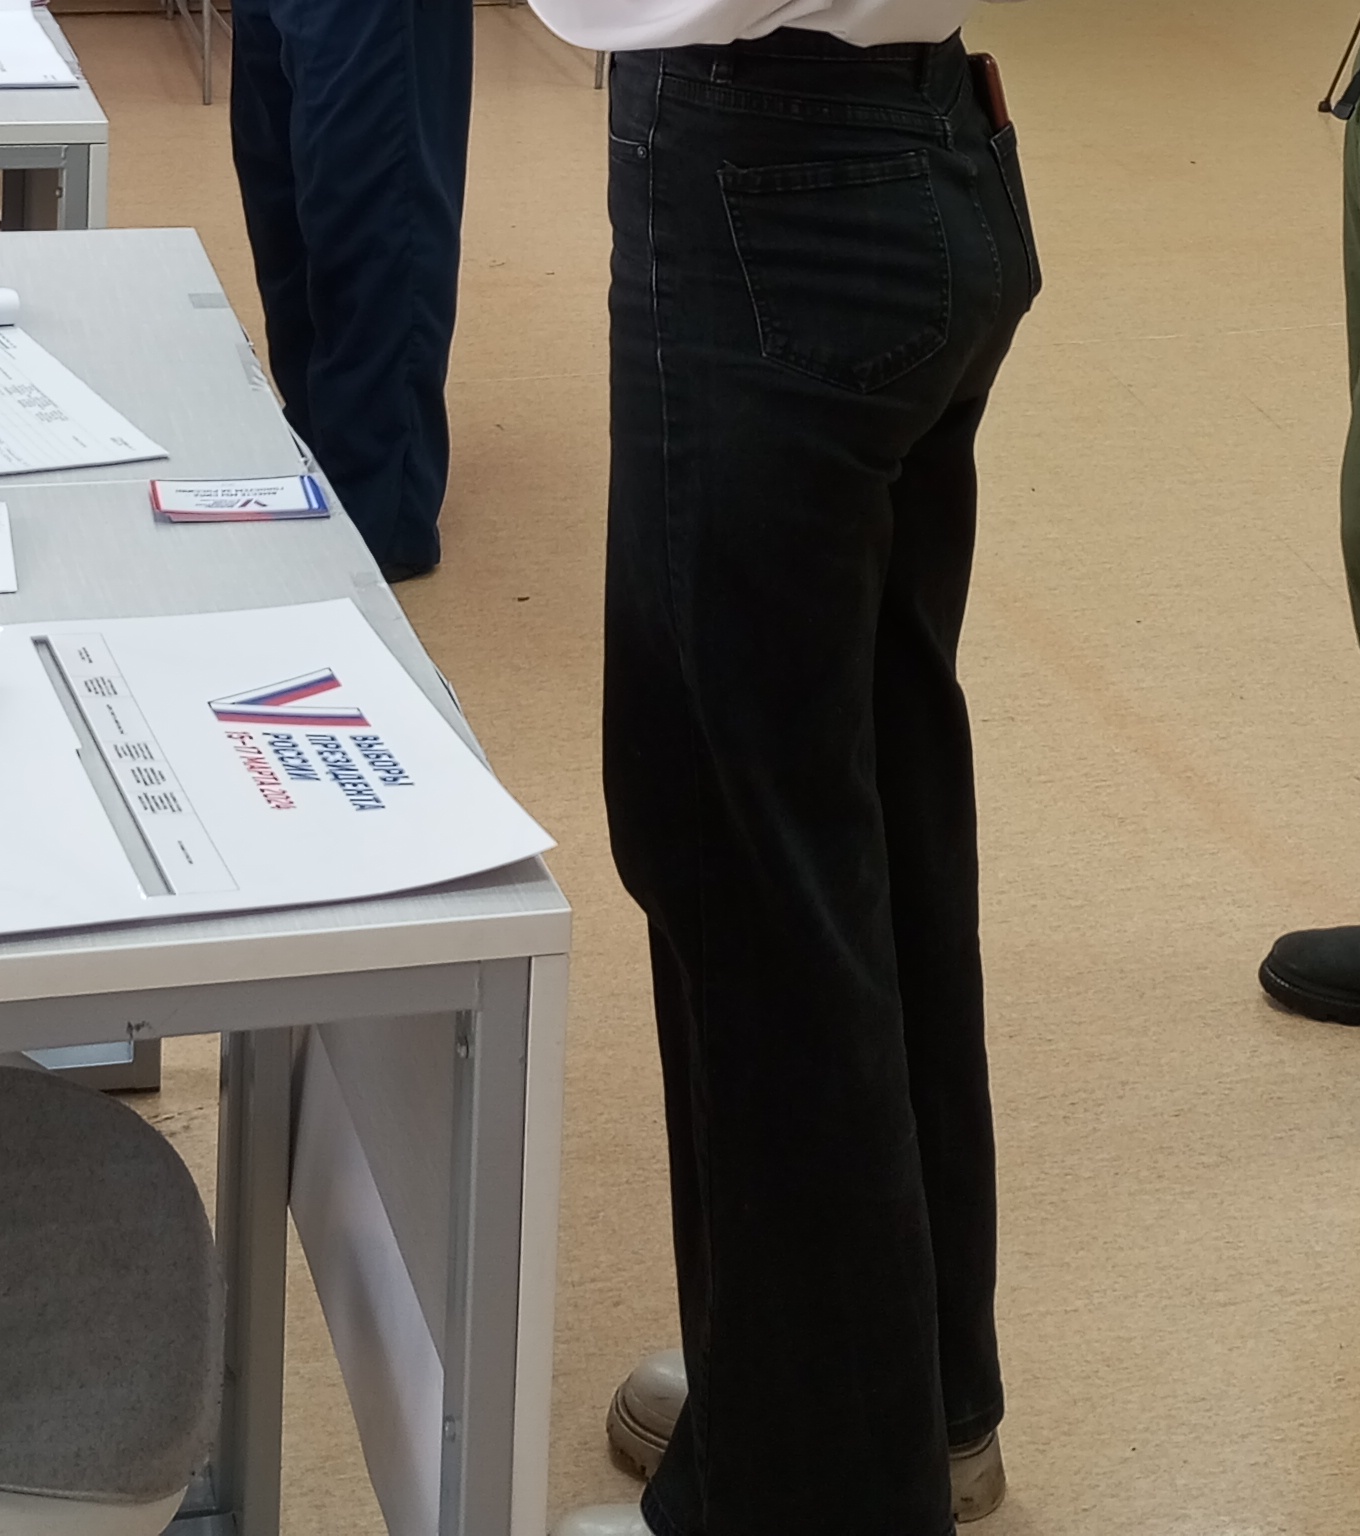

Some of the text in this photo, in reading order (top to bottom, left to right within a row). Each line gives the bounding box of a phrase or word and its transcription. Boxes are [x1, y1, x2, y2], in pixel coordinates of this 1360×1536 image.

[239, 755, 282, 787] МАРТА
[261, 731, 322, 782] РОССИИ
[304, 733, 387, 812] ПРЕЗИДЕНТА
[348, 734, 415, 786] ВЫБОРЫ
